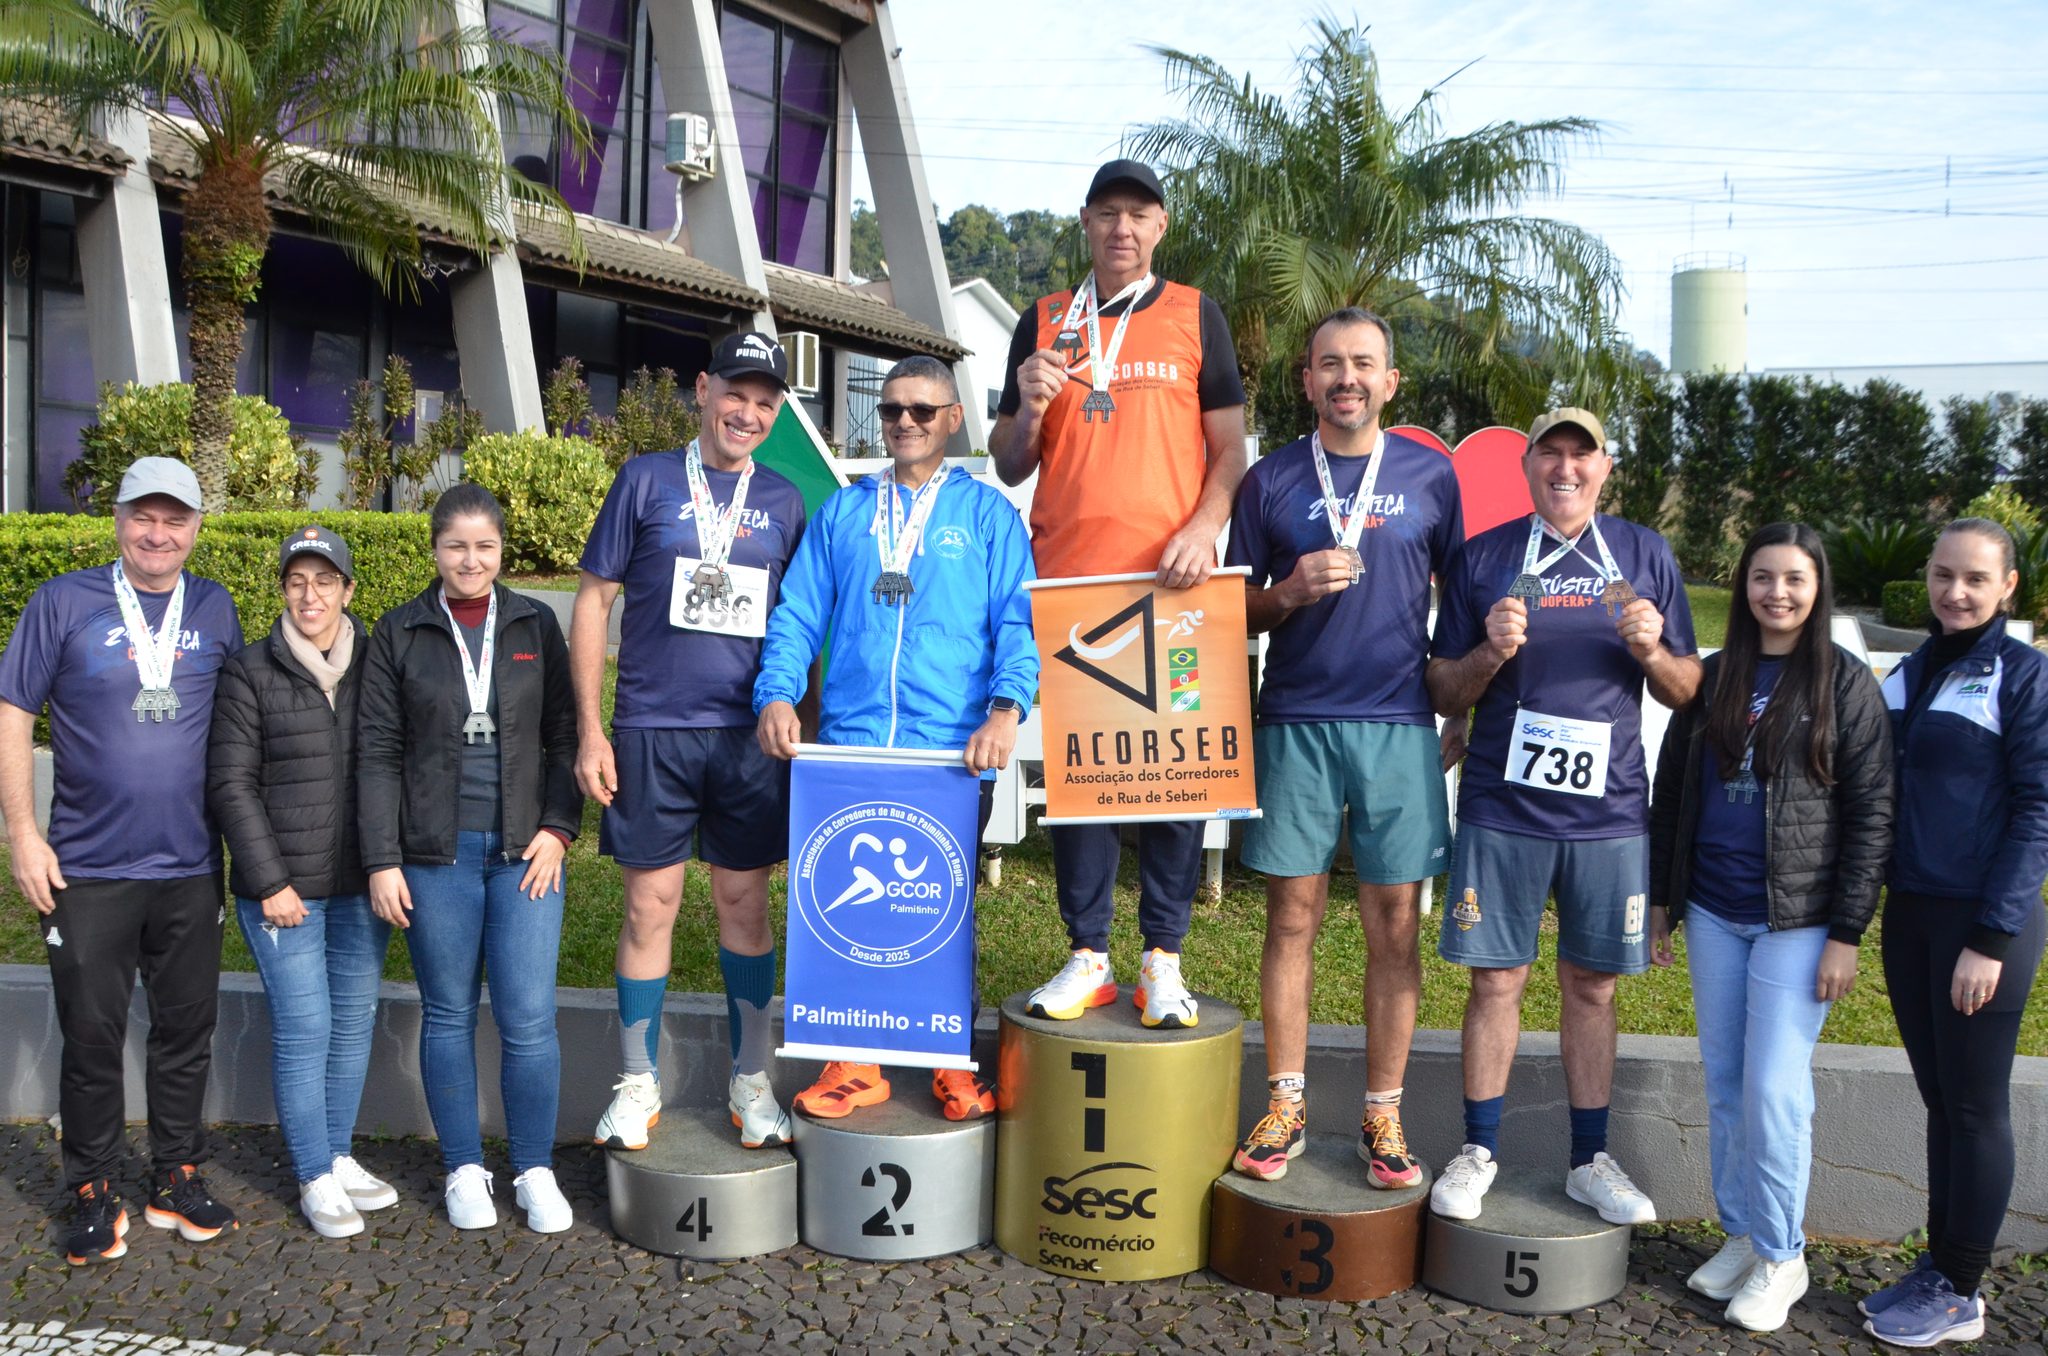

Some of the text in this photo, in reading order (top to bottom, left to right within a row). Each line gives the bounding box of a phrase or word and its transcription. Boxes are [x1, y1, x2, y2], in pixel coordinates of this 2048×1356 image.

[736, 348, 767, 360] PUMA
[1111, 361, 1178, 381] CORSEB
[289, 540, 332, 552] CRESOL
[1540, 573, 1606, 596] RÚSTIC
[1522, 723, 1555, 739] Sesc
[1066, 725, 1239, 767] ACORSEB
[1065, 767, 1239, 787] Associação dos Corredores
[1522, 741, 1594, 790] 738
[1097, 789, 1208, 805] de Rua de Seberi
[801, 834, 825, 879] Associação
[823, 826, 833, 837] de
[831, 808, 876, 830] Corredores
[878, 807, 888, 816] de
[890, 808, 905, 819] Rua
[907, 812, 918, 823] de
[917, 817, 953, 852] Palmitinho
[951, 858, 965, 887] Região
[886, 881, 942, 899] GCOR
[890, 904, 940, 915] Palmitinho
[850, 946, 911, 963] Desde 2025
[792, 1003, 909, 1031] Palmitinho
[931, 1013, 962, 1034] RS
[1071, 1052, 1107, 1152] 1
[861, 1162, 914, 1237] 2
[1041, 1174, 1157, 1221] Sesc
[675, 1197, 713, 1243] 4
[1039, 1225, 1155, 1252] Fecomércio
[1038, 1249, 1099, 1273] Senac
[1283, 1219, 1335, 1295] 3
[1503, 1250, 1541, 1298] 5
